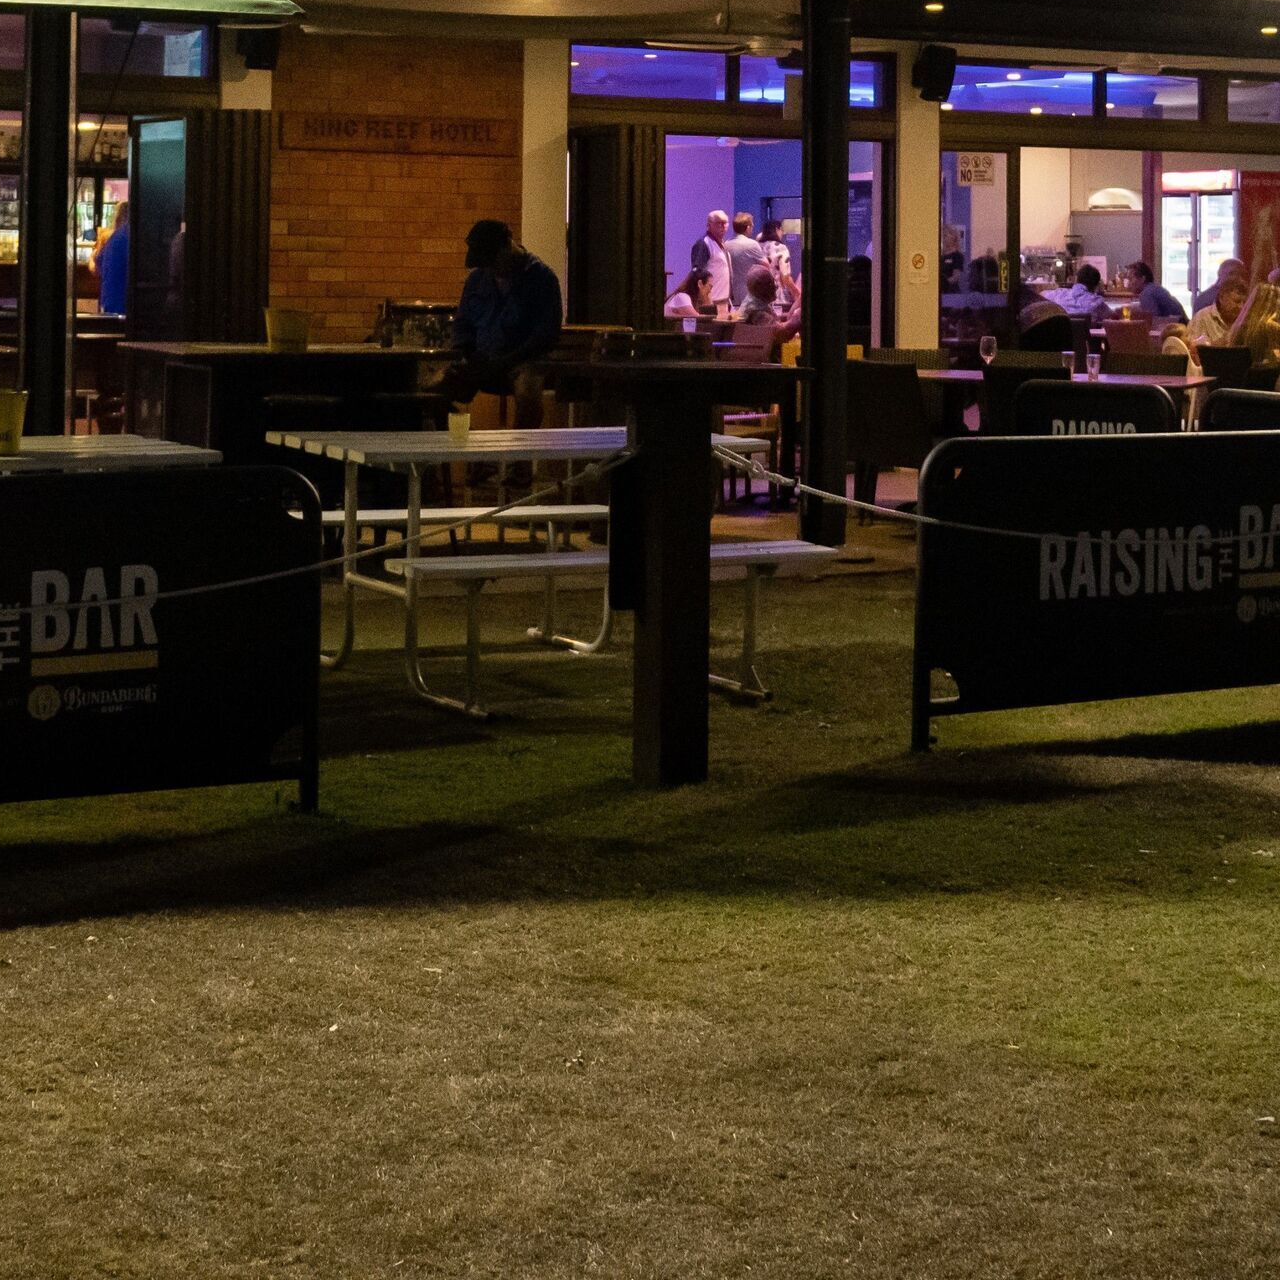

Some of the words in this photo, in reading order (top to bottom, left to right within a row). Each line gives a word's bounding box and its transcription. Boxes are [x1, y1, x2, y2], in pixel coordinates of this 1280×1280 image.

[303, 118, 358, 137] KING
[365, 120, 420, 140] REEF
[430, 122, 497, 143] HOTEL
[960, 169, 972, 182] NO
[1039, 524, 1213, 600] RAISING
[1219, 528, 1234, 583] THE
[31, 563, 160, 653] BAR
[63, 683, 159, 711] BUNDABERG
